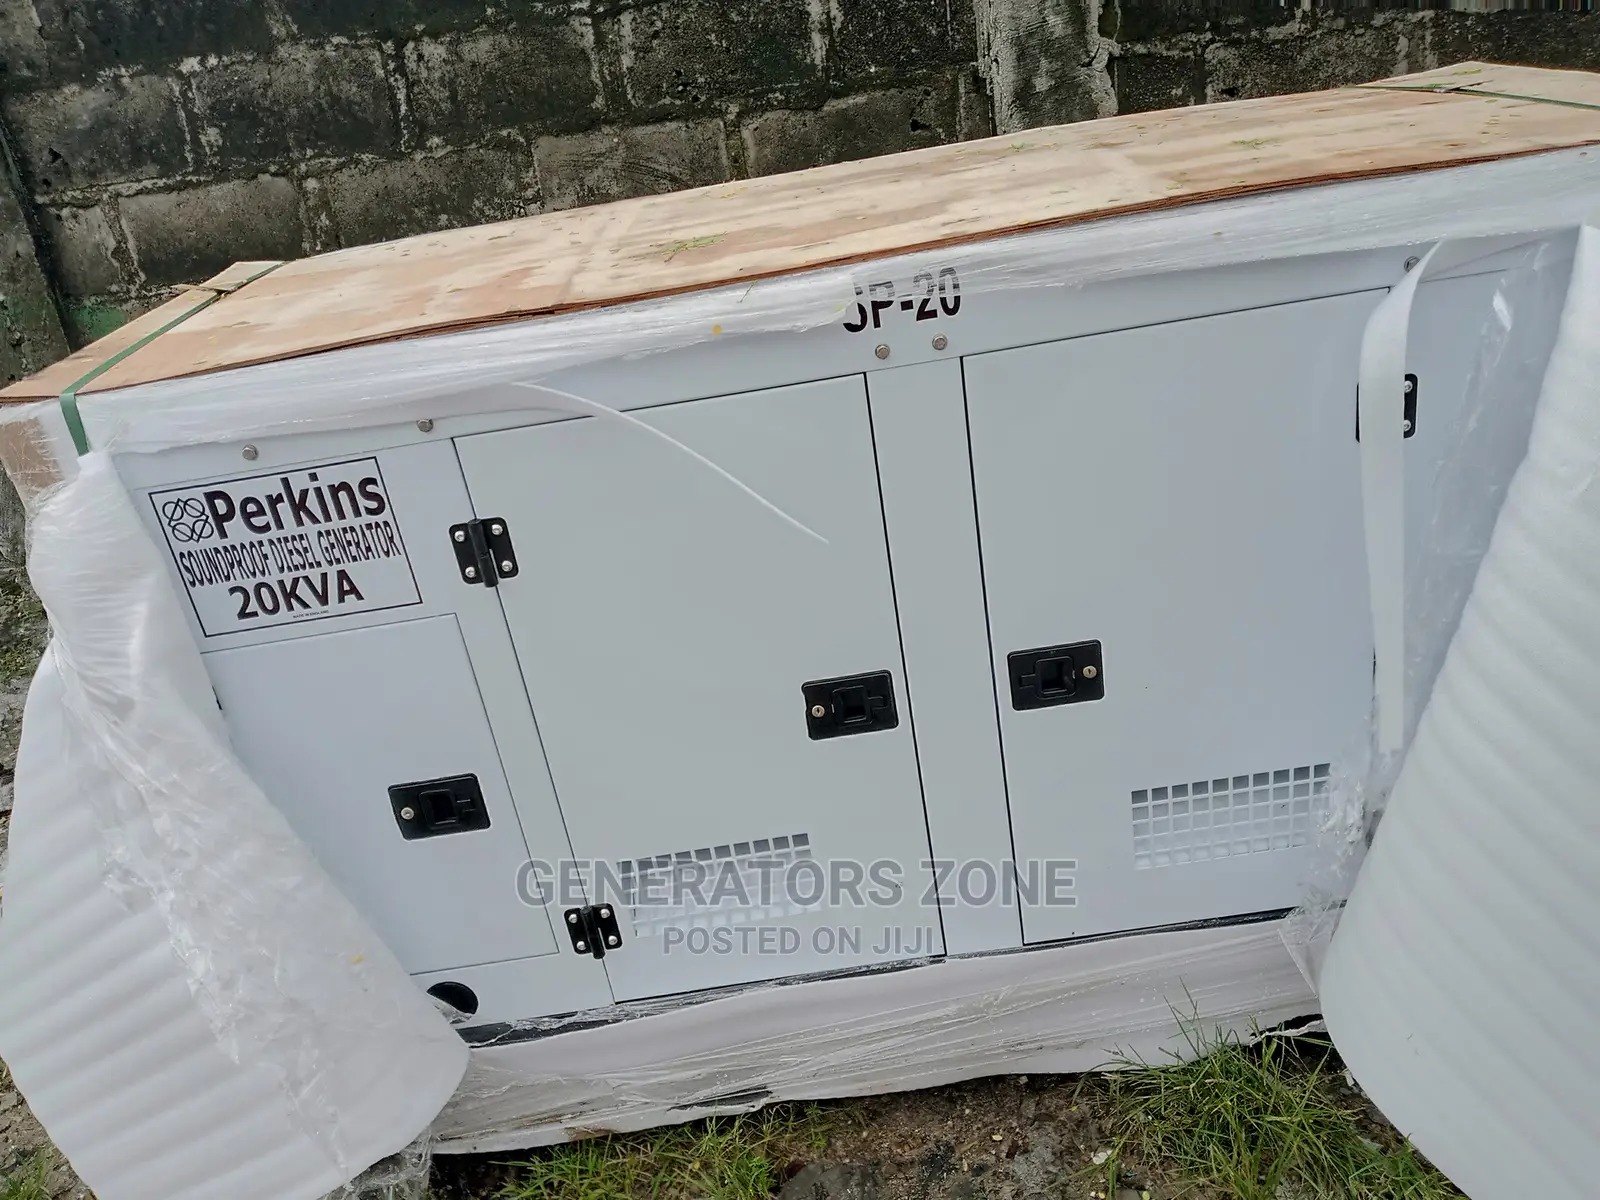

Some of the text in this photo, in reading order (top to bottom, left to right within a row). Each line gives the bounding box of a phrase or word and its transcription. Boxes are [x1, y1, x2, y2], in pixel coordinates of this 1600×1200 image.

[203, 472, 386, 540] Perkins
[178, 520, 402, 588] SOUNDPROOF DIESEL GENERATOR
[228, 569, 365, 621] 20KVA
